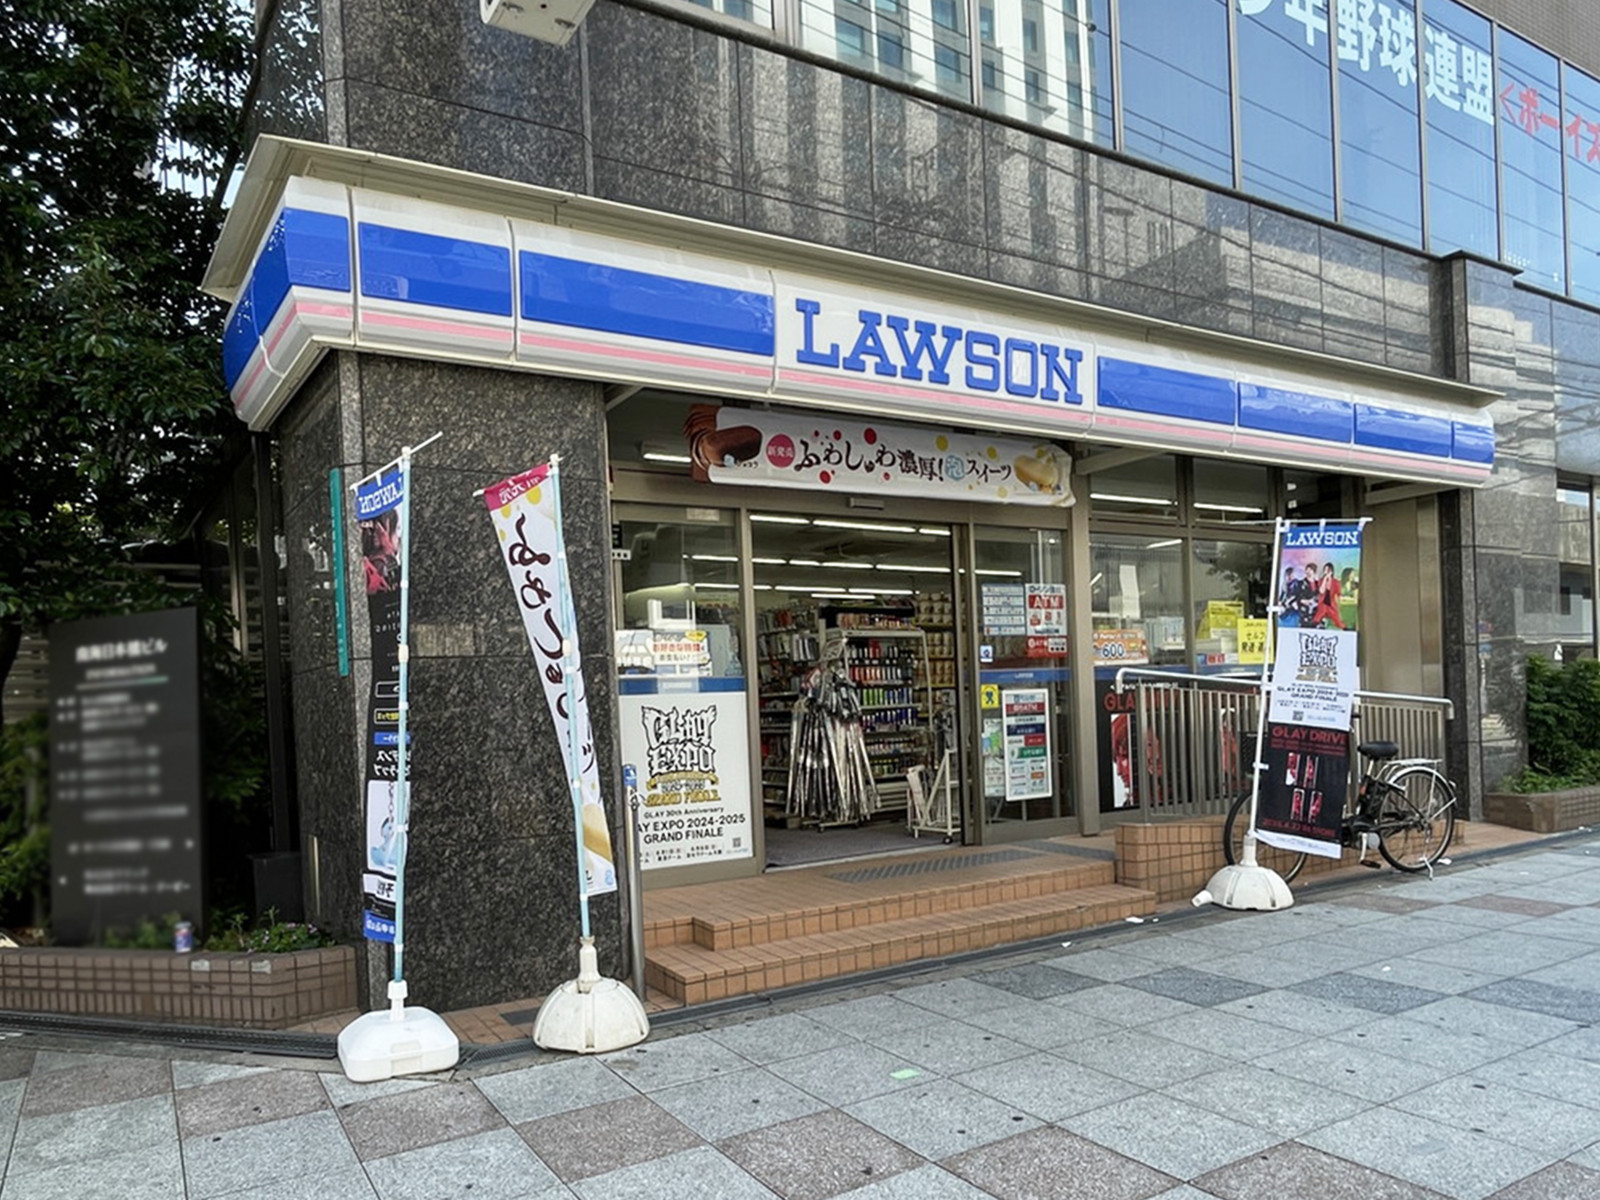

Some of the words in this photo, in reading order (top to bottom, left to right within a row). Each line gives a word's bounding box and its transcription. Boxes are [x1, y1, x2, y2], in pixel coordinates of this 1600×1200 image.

[1239, 0, 1493, 126] 年野球連盟
[795, 297, 1083, 406] LAWSON
[1286, 531, 1359, 547] LAWSON
[1032, 595, 1059, 609] ATM
[1102, 643, 1125, 658] 600
[641, 705, 717, 751] GLAY
[1272, 726, 1308, 740] GLAY
[647, 741, 716, 777] EXPO
[644, 811, 665, 819] GLAY
[684, 807, 724, 816] Anniversary
[653, 819, 685, 832] EXPO
[687, 814, 746, 828] 2024-2025
[644, 831, 683, 844] GRAND
[685, 827, 724, 840] FINALE
